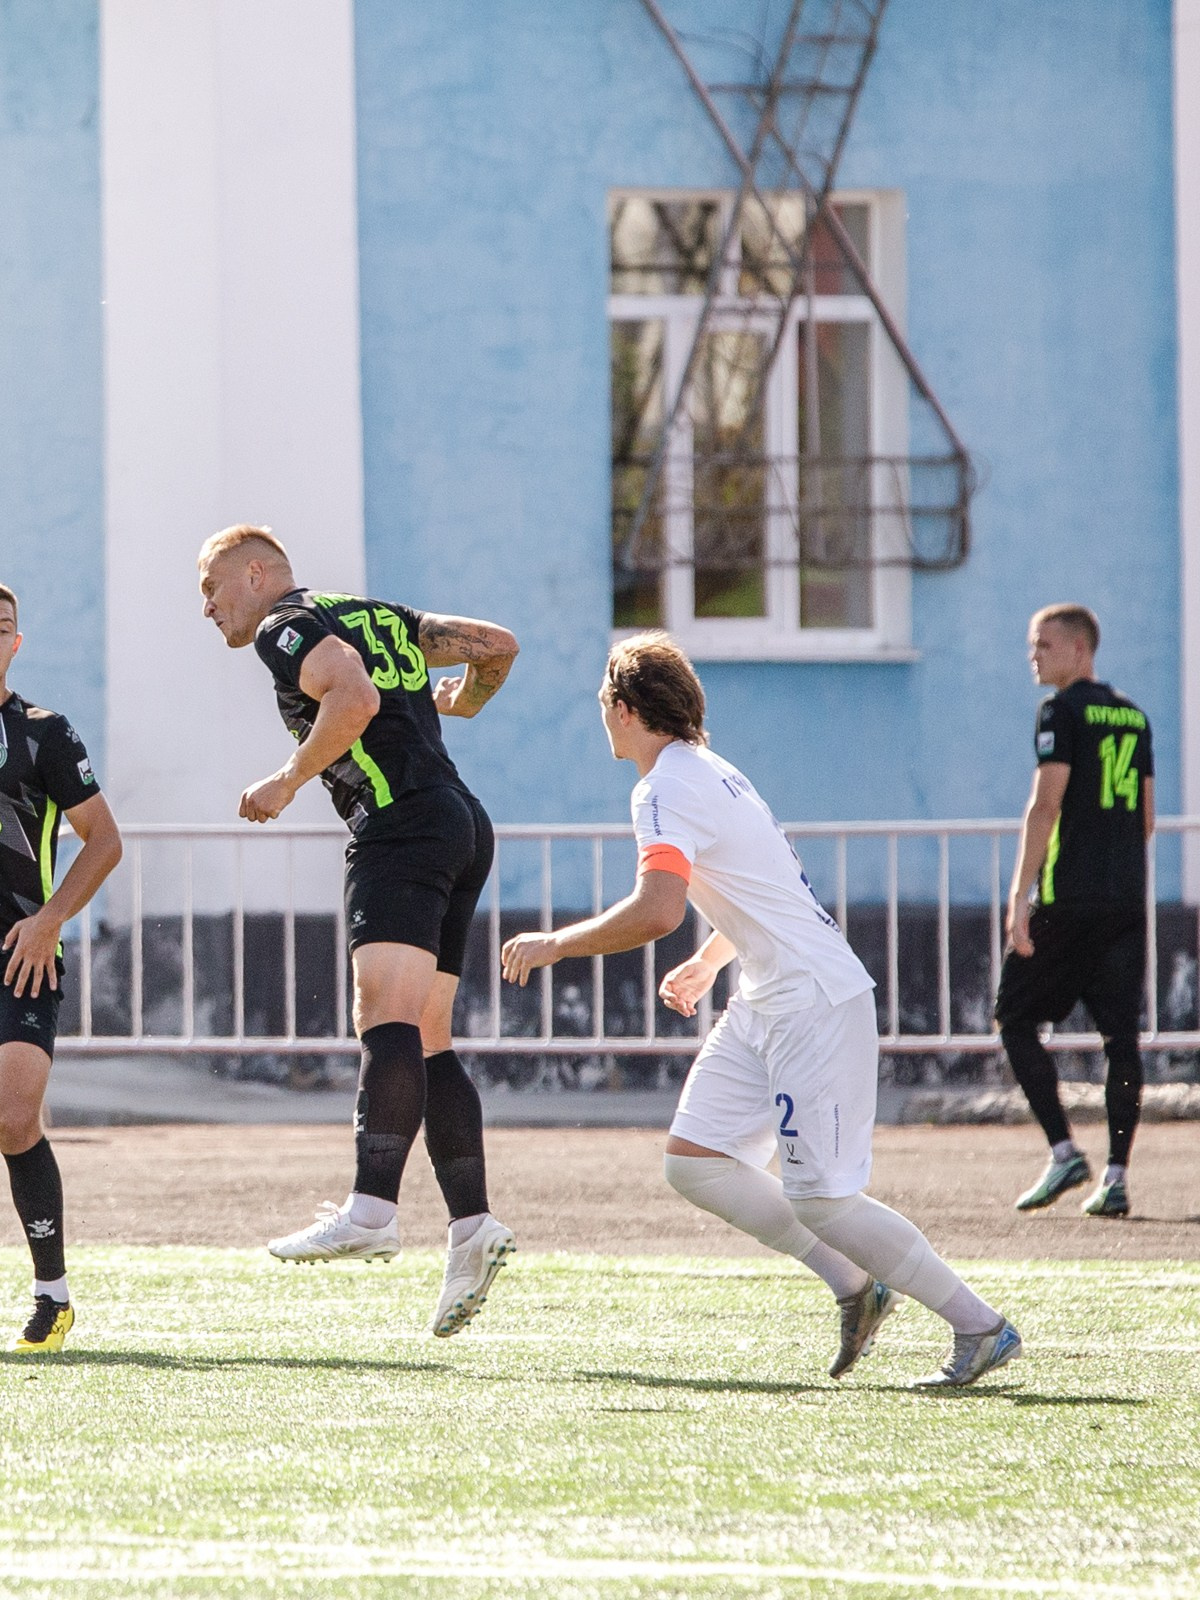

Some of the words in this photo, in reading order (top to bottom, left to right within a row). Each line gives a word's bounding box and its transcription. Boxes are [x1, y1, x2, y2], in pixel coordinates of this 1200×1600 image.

[338, 607, 429, 692] 33
[1099, 732, 1139, 811] 14
[775, 1092, 799, 1138] 2
